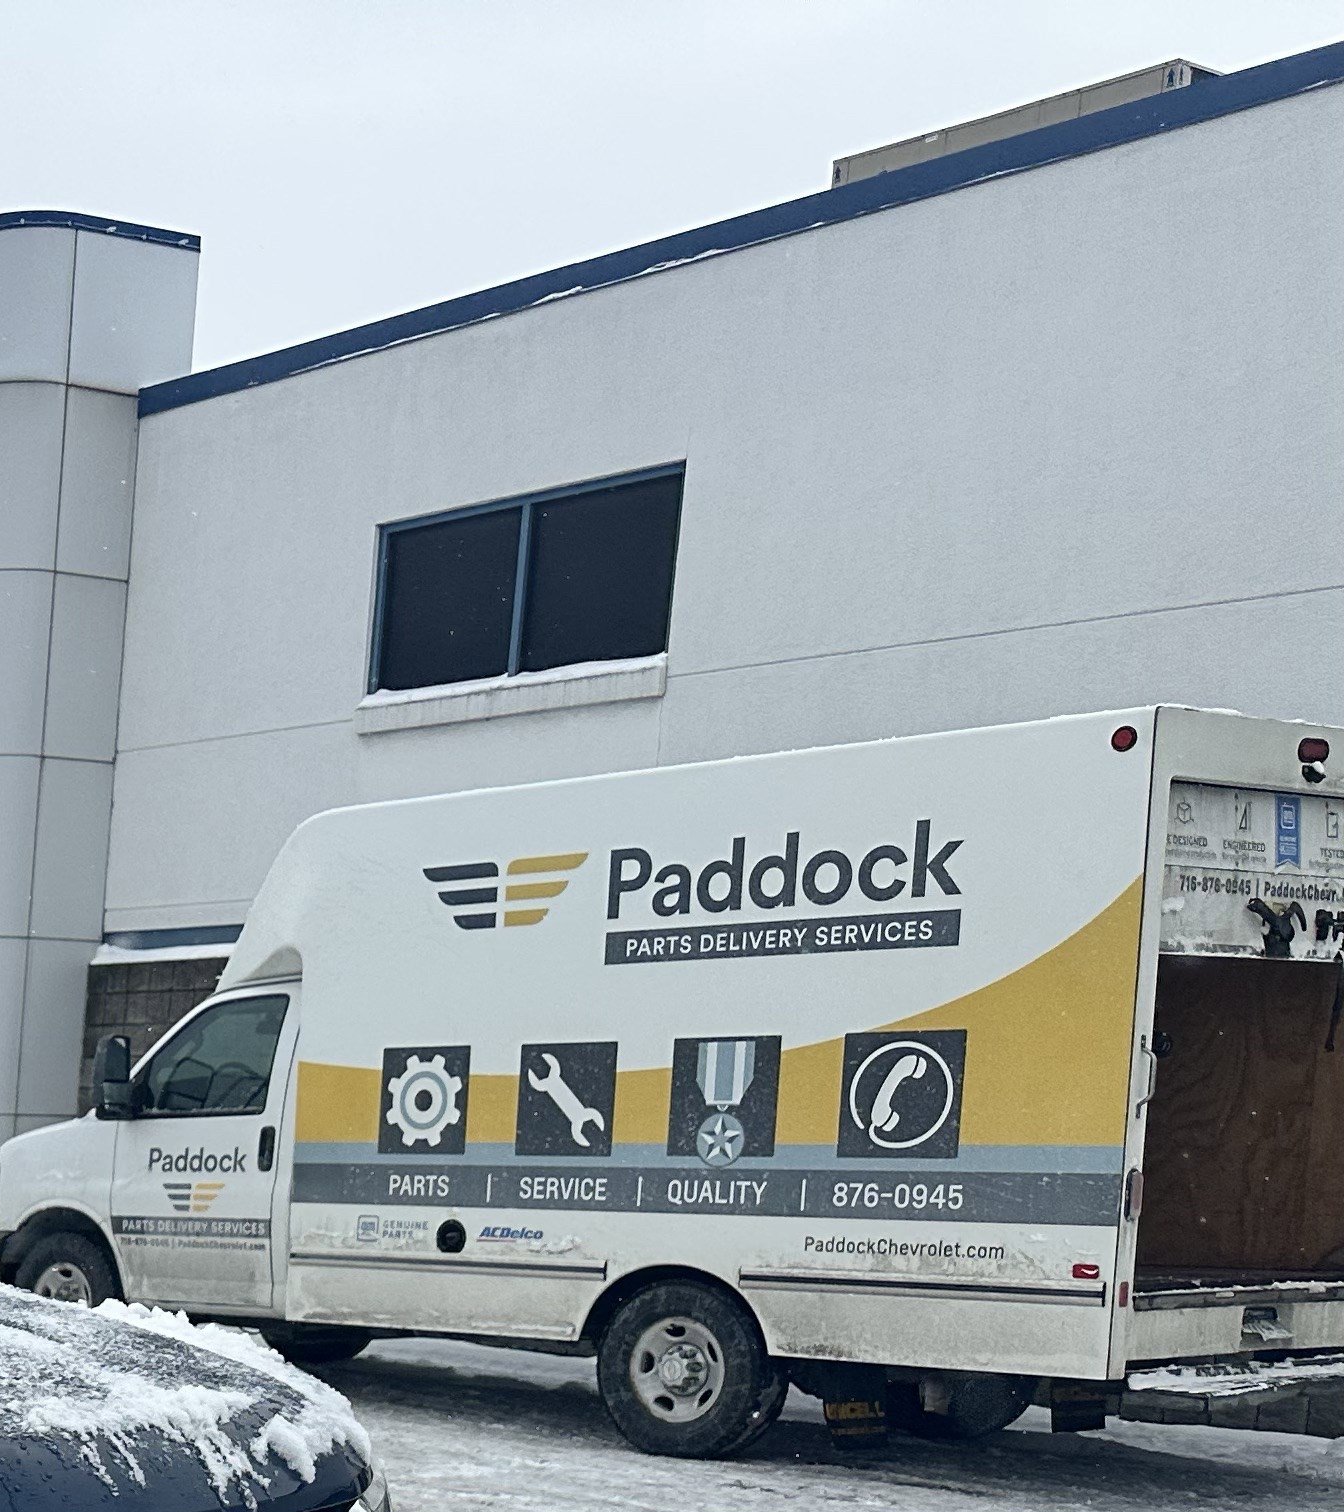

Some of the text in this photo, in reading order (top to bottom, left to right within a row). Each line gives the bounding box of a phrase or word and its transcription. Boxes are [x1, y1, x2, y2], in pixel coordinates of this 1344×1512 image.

[606, 818, 965, 920] Paddock
[1179, 874, 1252, 897] 716-876-0945
[625, 919, 934, 957] PARTS DELIVERY SERVICES
[148, 1146, 248, 1173] Paddock
[388, 1175, 965, 1210] PARTS SERVICE QUALITY 876-0945
[121, 1219, 266, 1236] PARTS DELIVERY SERVICES
[479, 1226, 544, 1240] ACDelco
[803, 1236, 1006, 1262] PaddockChevrolet.com
